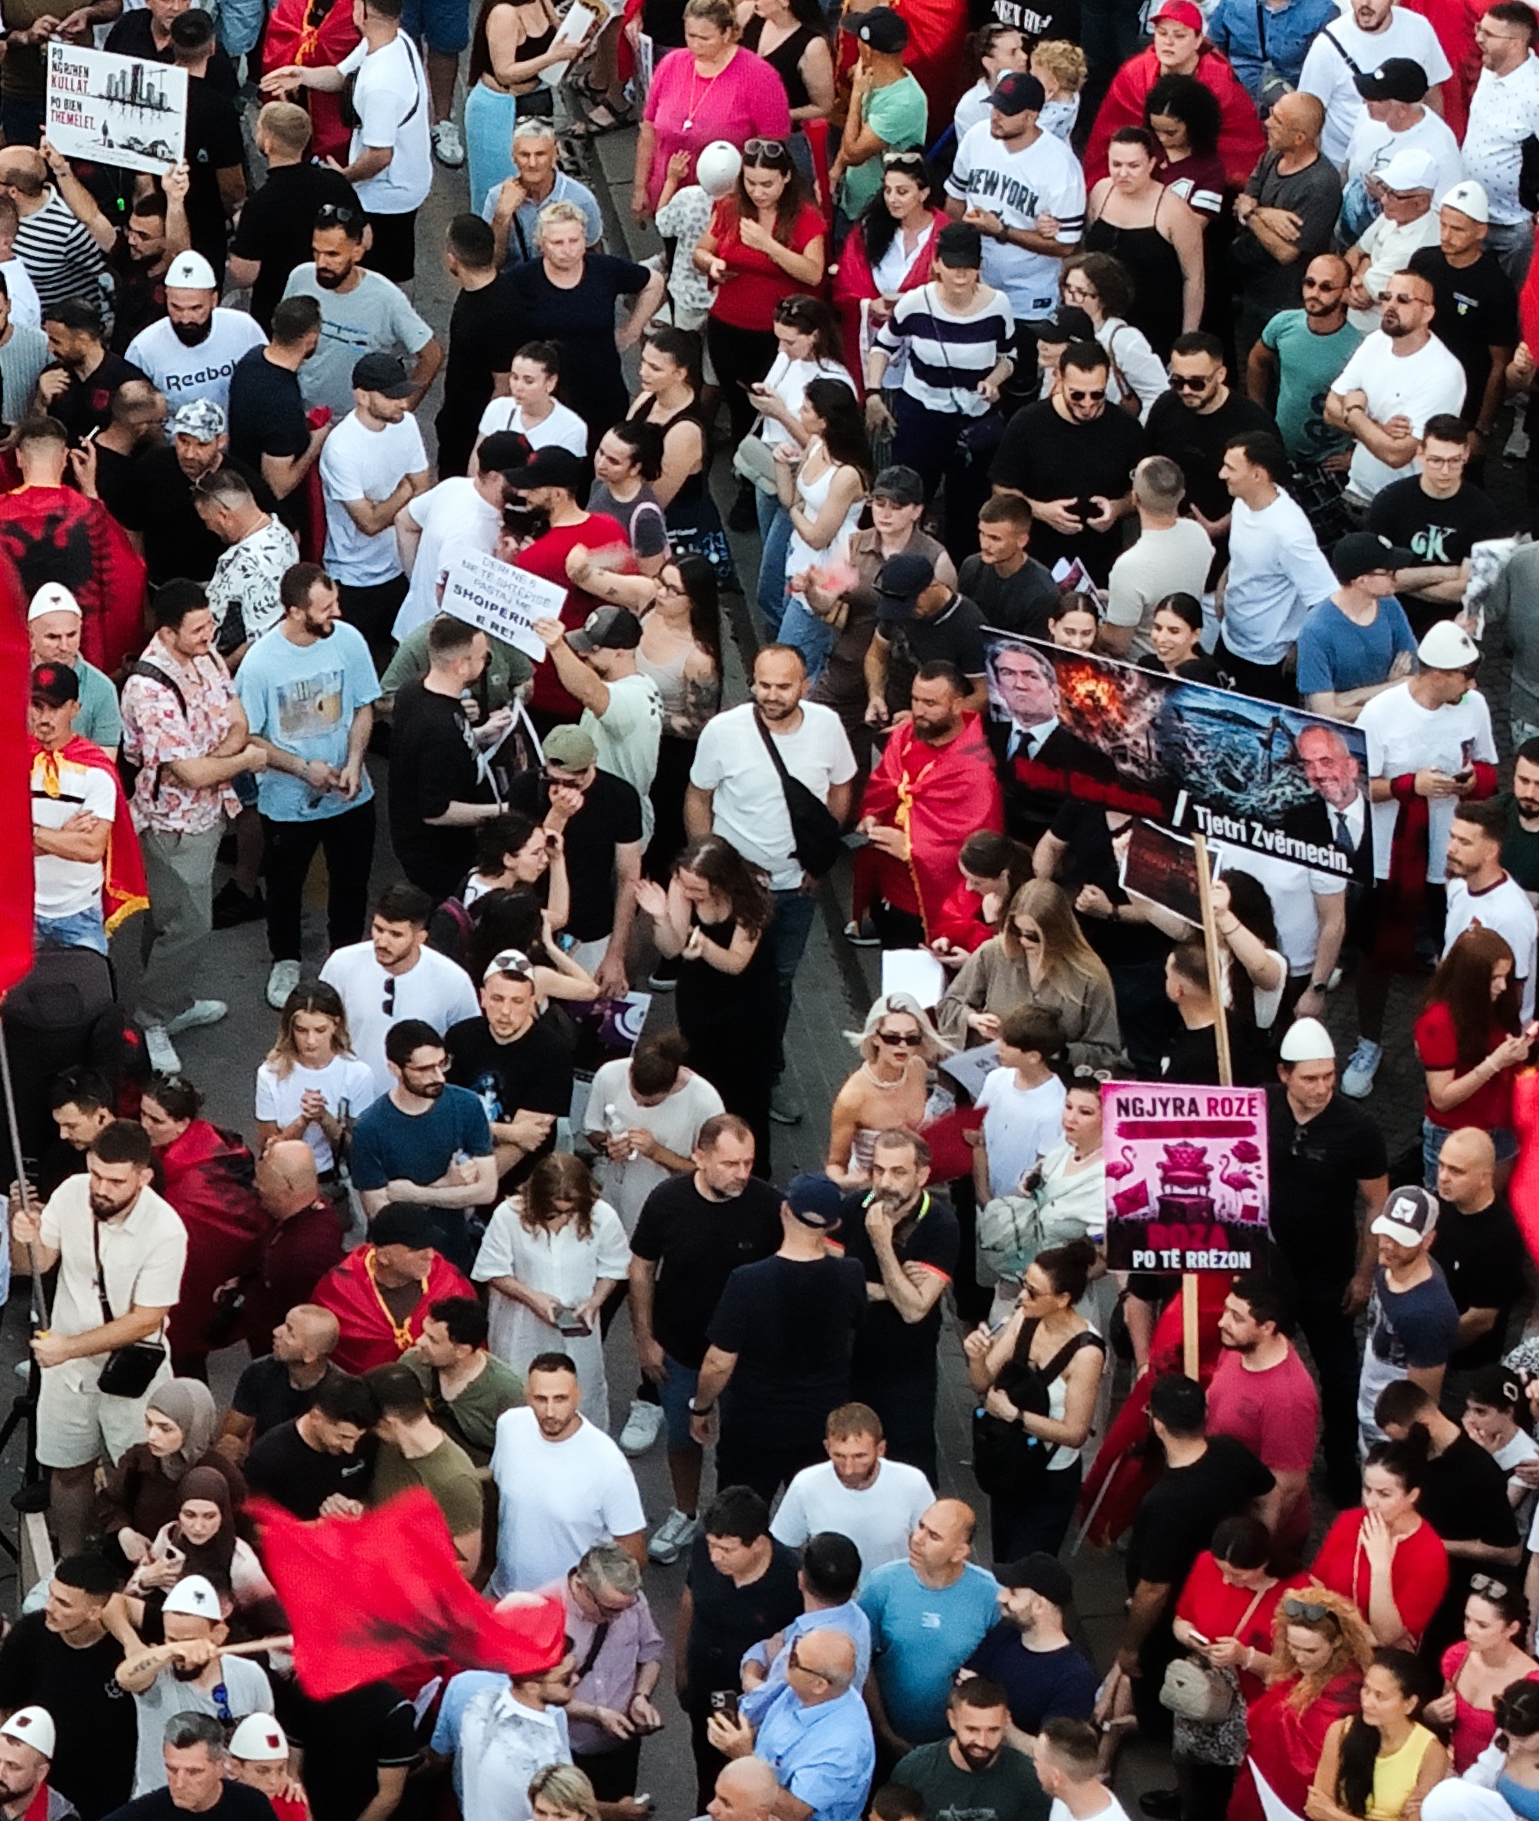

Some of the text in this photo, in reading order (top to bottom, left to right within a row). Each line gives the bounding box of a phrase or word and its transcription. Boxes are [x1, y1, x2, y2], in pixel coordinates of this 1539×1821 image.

[967, 168, 1038, 217] NEW YORK
[165, 365, 234, 393] Reebo
[1194, 804, 1354, 875] Tjetri Zvërnecin.
[1115, 1098, 1201, 1119] NGJYRA
[1147, 1222, 1229, 1250] ROZA
[1131, 1249, 1154, 1270] PO
